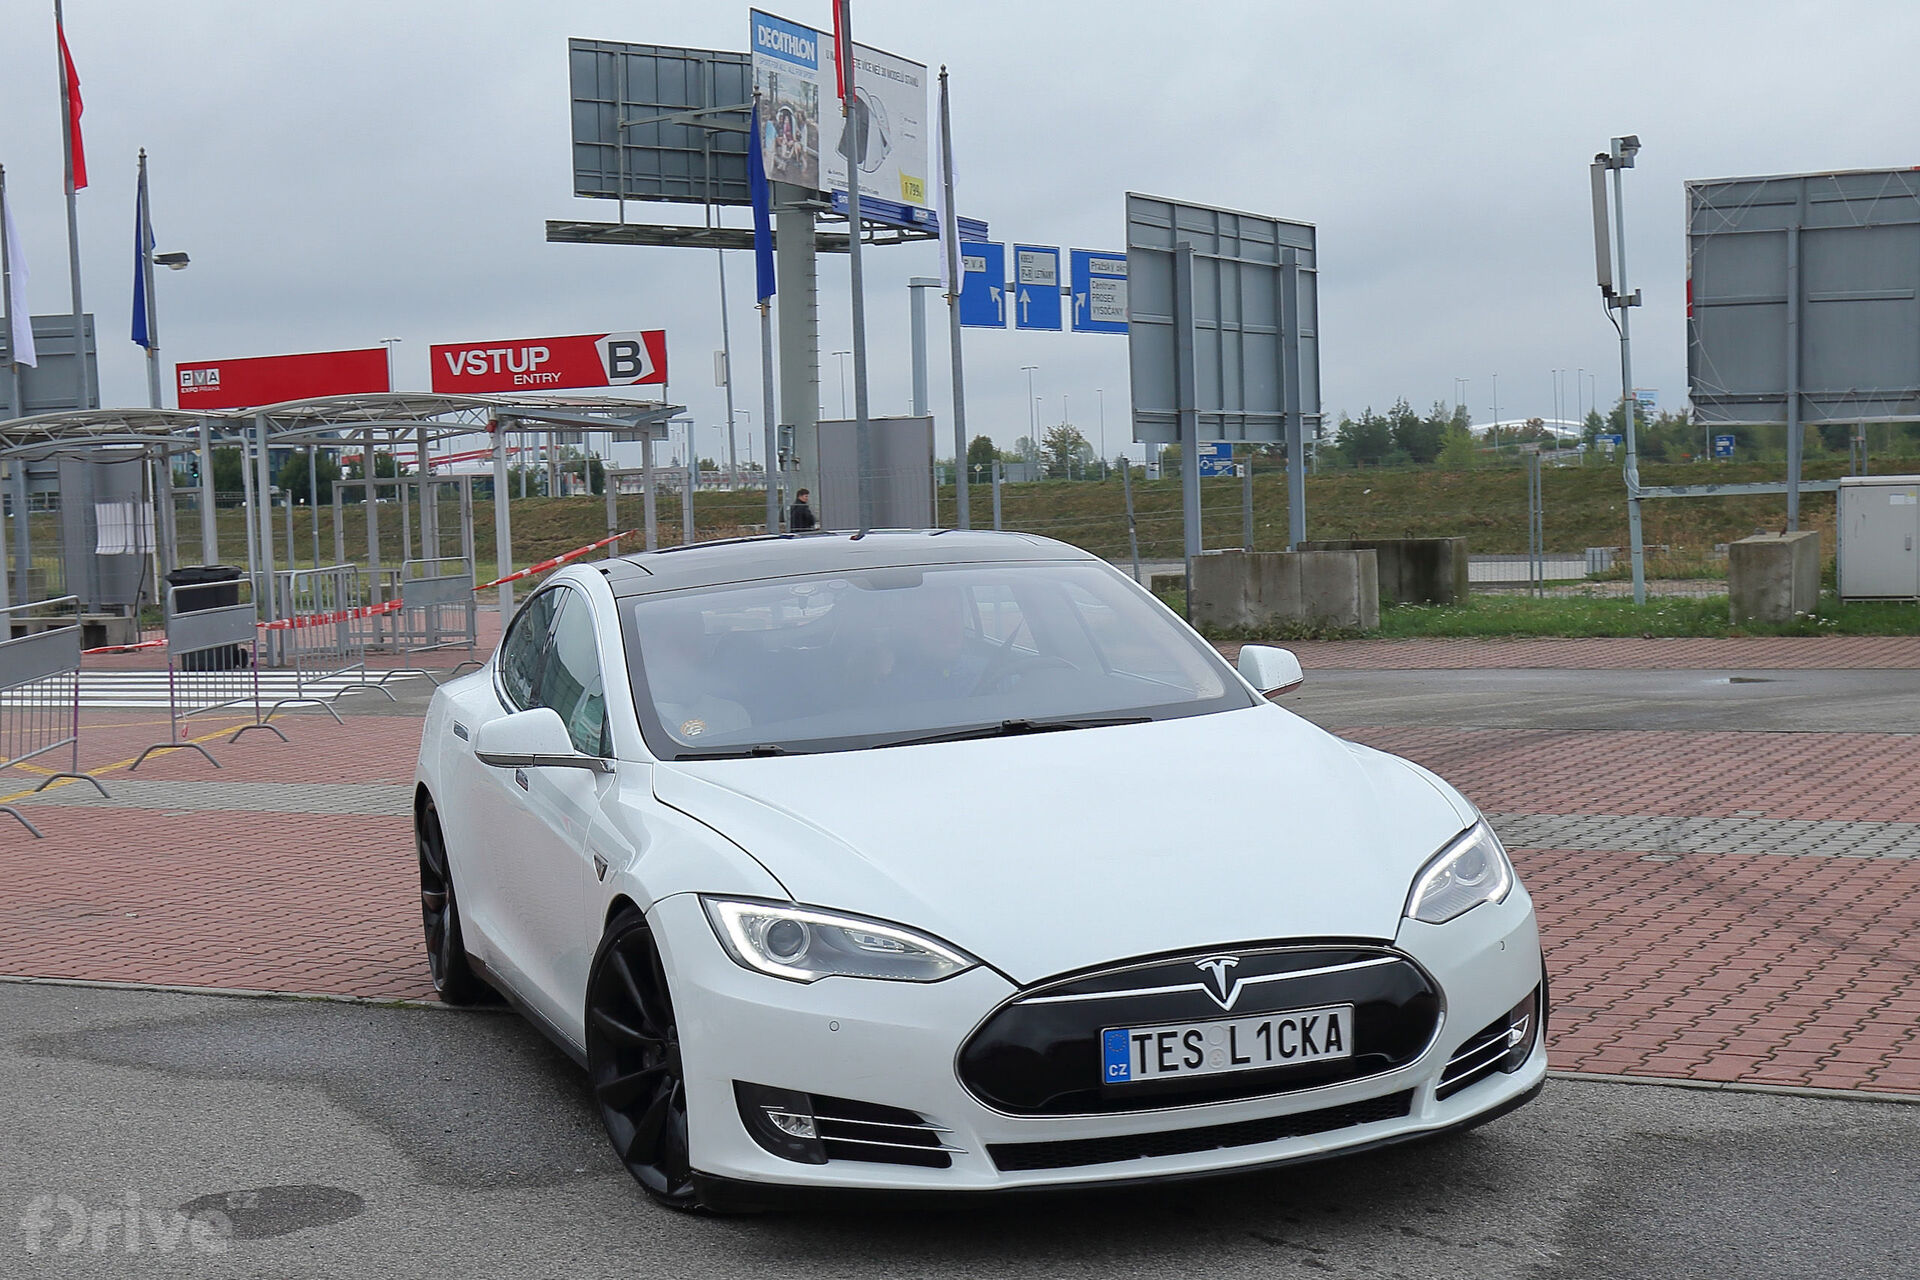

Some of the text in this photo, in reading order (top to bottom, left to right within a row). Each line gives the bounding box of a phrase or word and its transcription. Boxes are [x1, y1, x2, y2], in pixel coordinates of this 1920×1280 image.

[757, 24, 815, 62] DECATHLON
[1092, 280, 1117, 291] Centrum
[1092, 293, 1116, 303] PROSEK
[444, 346, 550, 376] VSTUP
[608, 340, 642, 379] B
[181, 371, 219, 385] PVA
[513, 372, 562, 385] ENTRY
[181, 386, 198, 394] EXPO
[1131, 1028, 1204, 1075] TES
[1108, 1063, 1128, 1076] CZ
